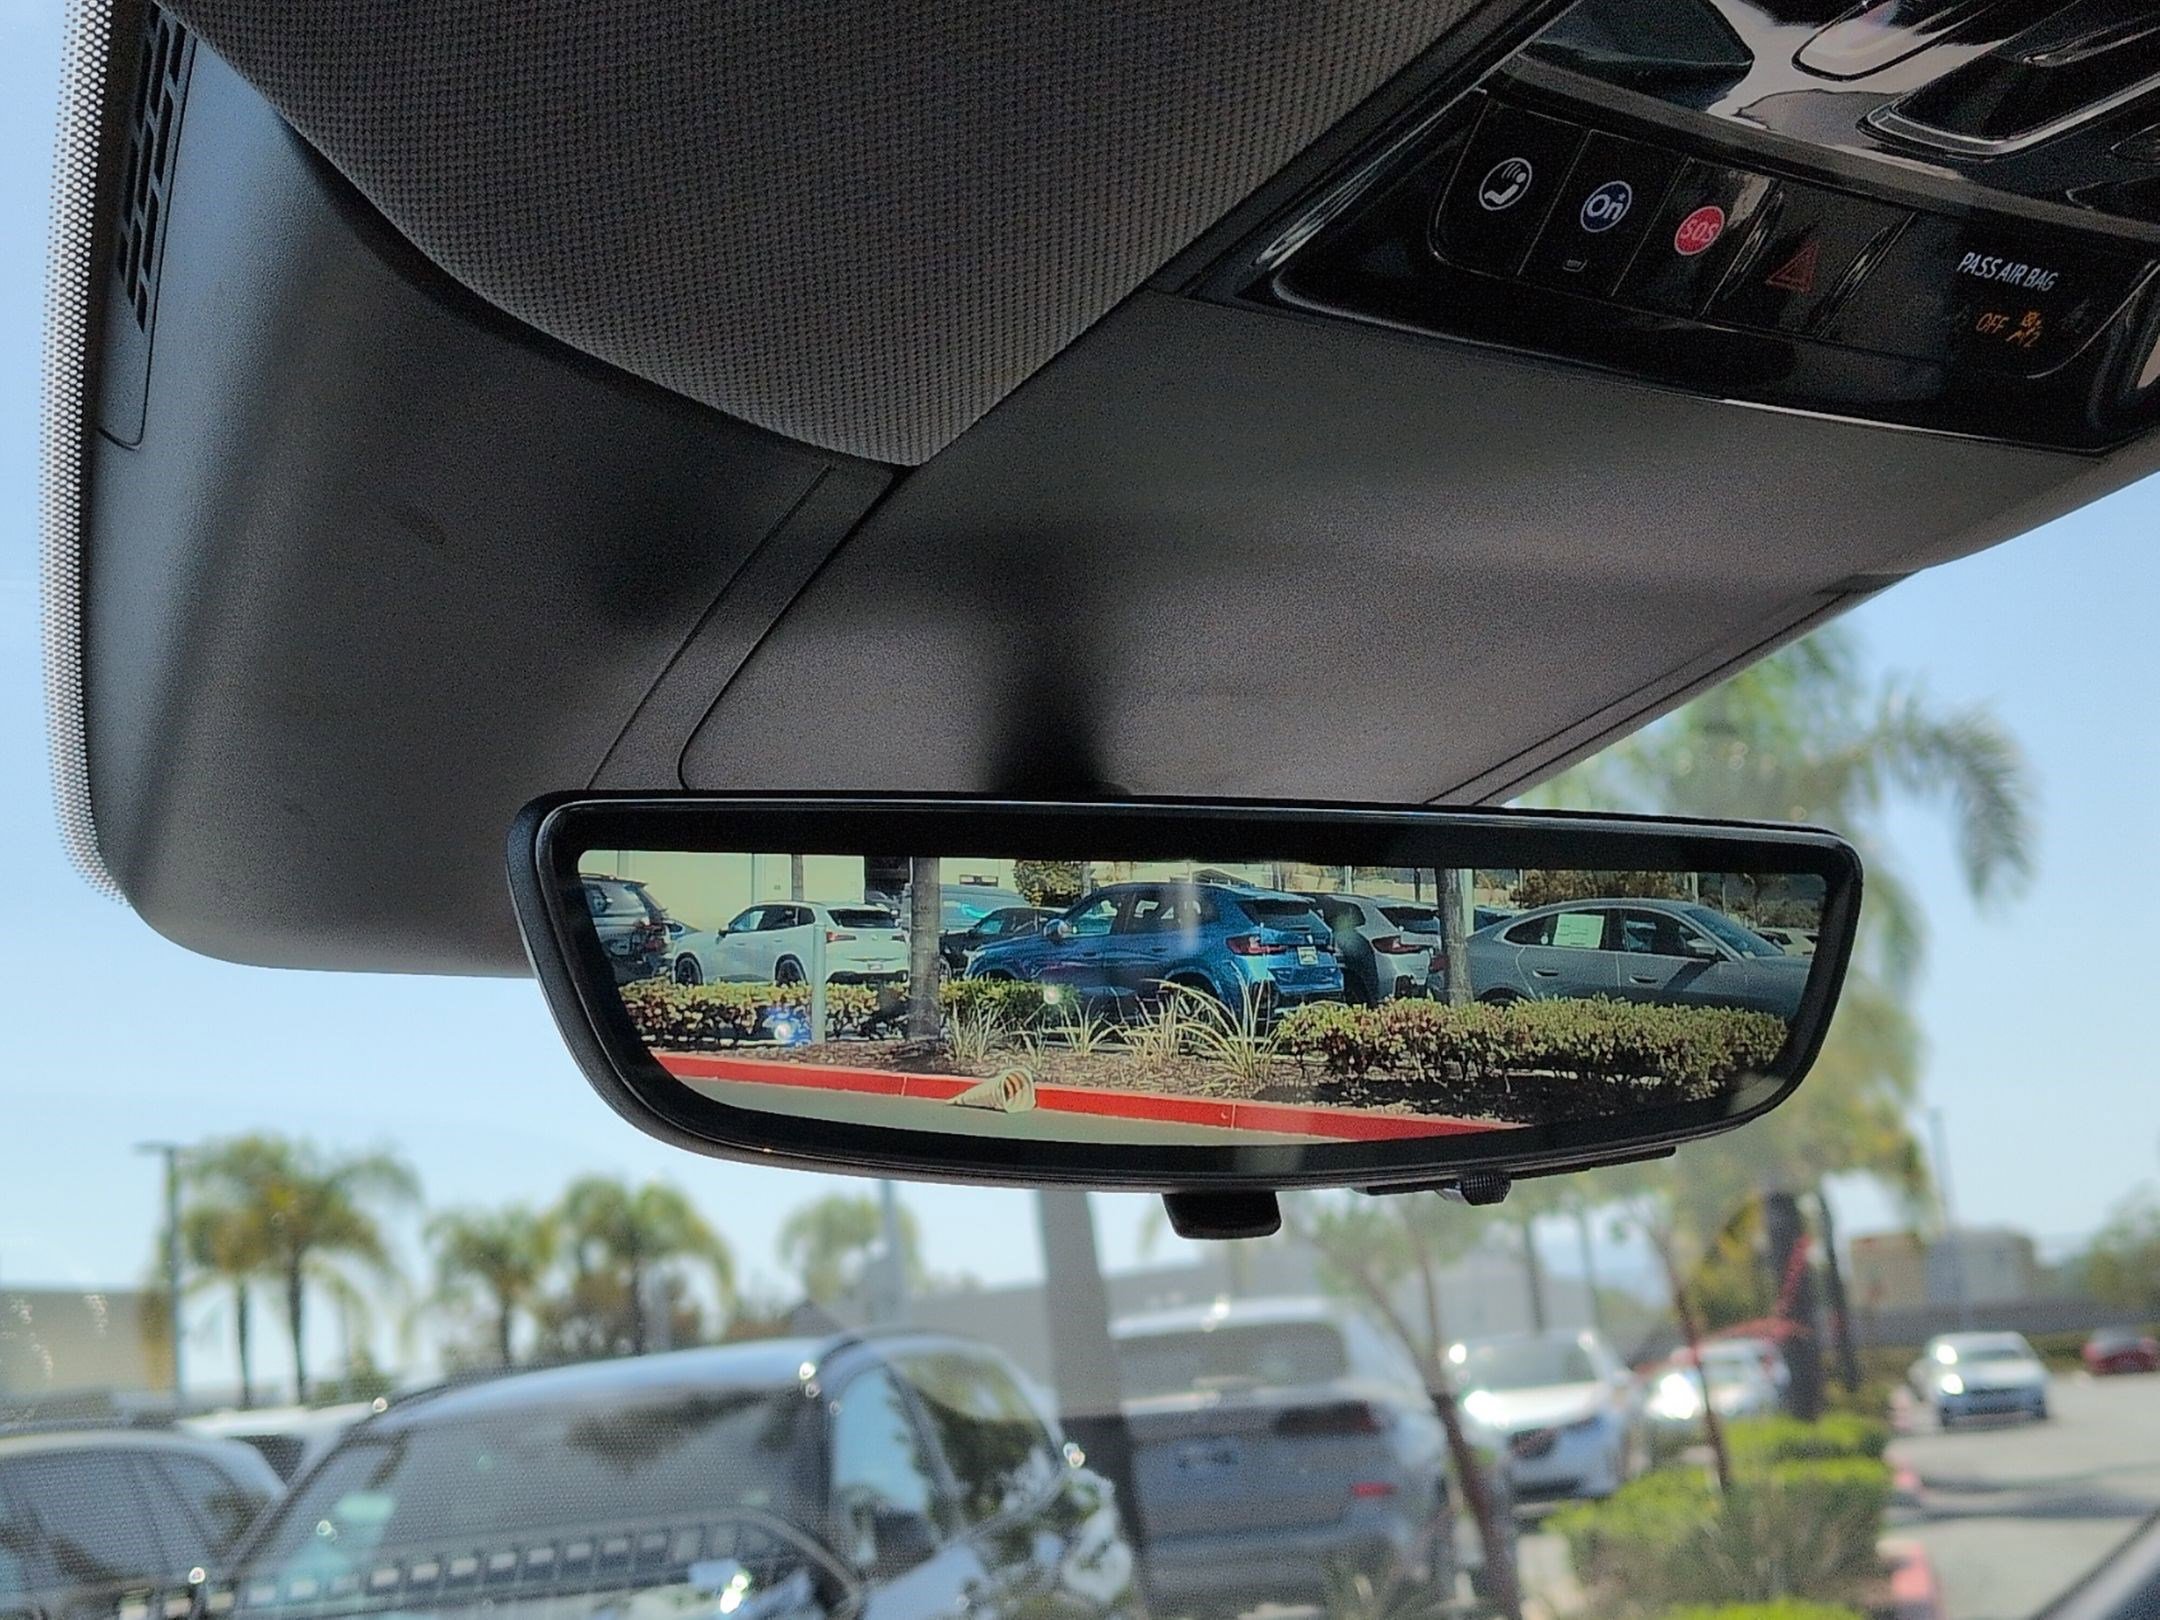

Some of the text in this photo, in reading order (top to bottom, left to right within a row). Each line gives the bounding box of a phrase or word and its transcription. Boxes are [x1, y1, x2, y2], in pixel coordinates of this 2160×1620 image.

[1586, 193, 1625, 220] On
[1680, 218, 1719, 243] SOS
[1956, 251, 2059, 292] PASS AIR BAG
[1975, 312, 2010, 334] OFF
